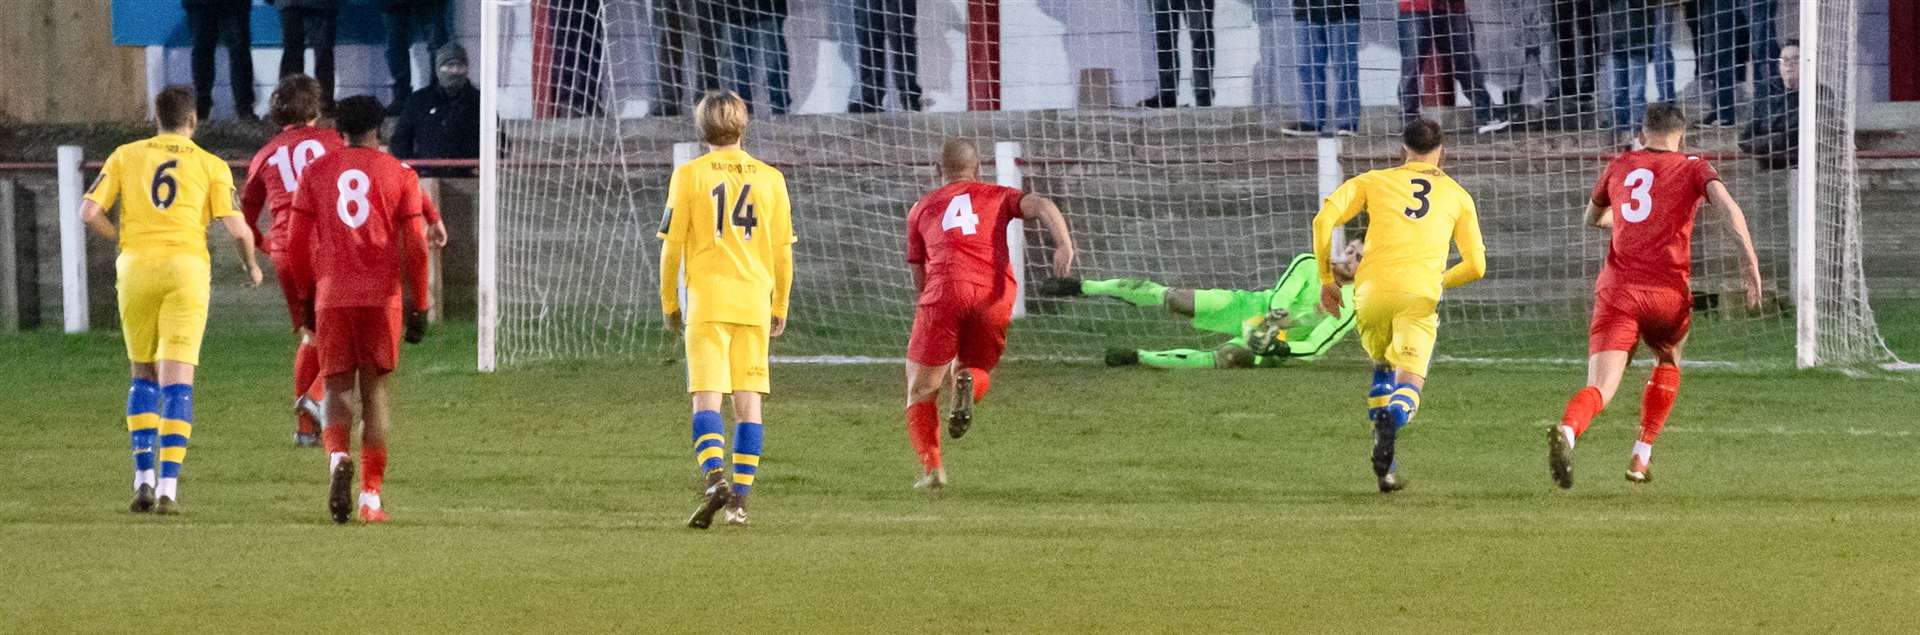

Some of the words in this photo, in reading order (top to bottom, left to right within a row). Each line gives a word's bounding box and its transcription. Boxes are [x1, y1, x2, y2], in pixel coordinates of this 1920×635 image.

[151, 159, 177, 209] 6
[267, 139, 326, 193] 10
[337, 168, 370, 229] 8
[711, 182, 758, 240] 14
[941, 192, 980, 236] 4
[1404, 178, 1432, 218] 3
[1620, 167, 1655, 223] 3
